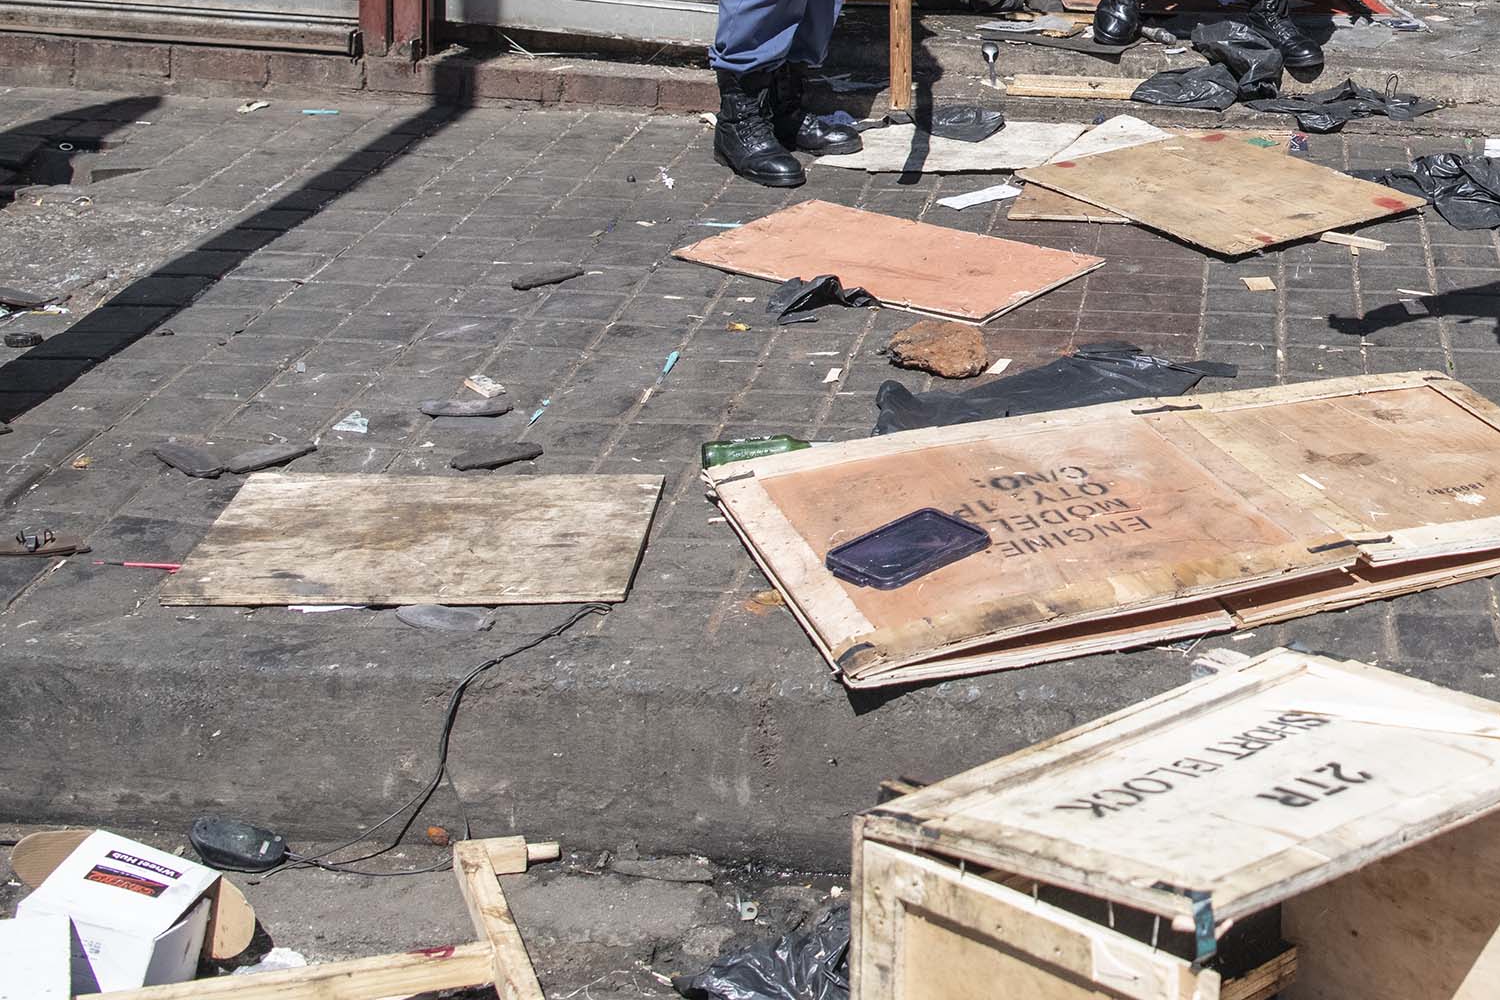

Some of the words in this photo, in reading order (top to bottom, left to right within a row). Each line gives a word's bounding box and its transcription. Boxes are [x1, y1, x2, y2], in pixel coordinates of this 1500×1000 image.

[1204, 711, 1332, 761] SHORT
[1053, 757, 1225, 818] BLOCK
[1256, 761, 1374, 808] 2TR
[112, 851, 139, 864] Hub
[138, 858, 176, 878] Wheel
